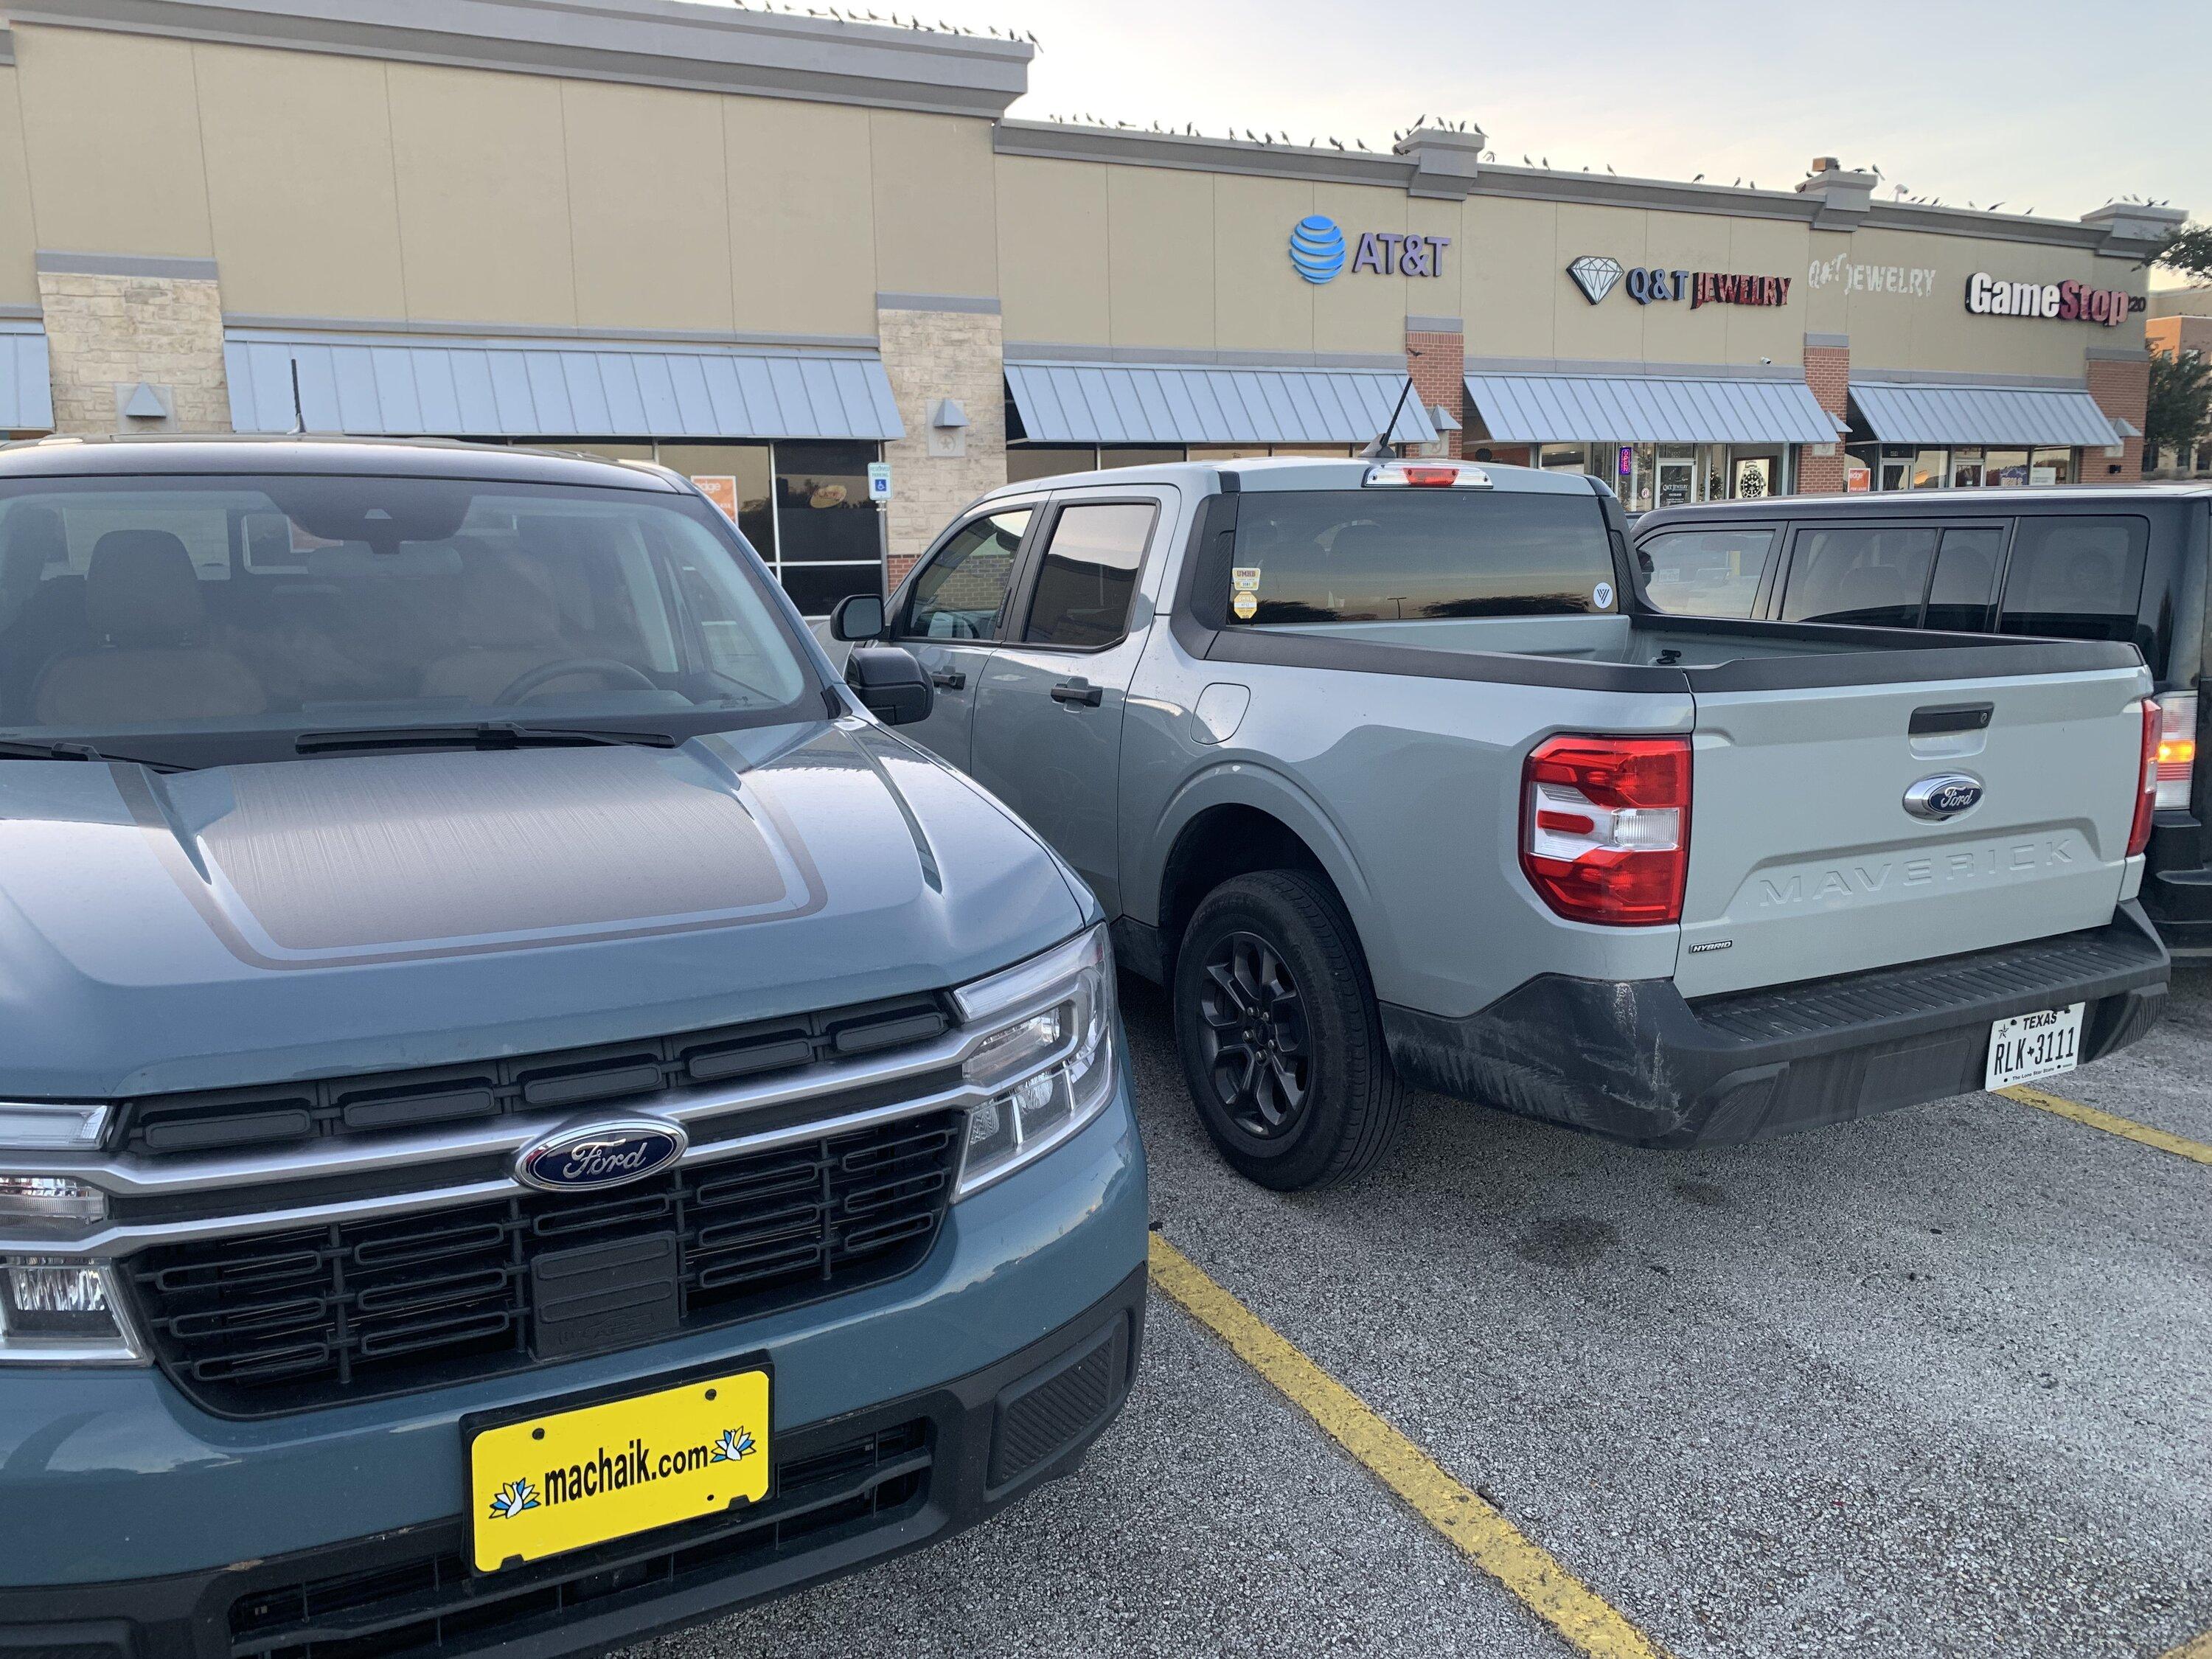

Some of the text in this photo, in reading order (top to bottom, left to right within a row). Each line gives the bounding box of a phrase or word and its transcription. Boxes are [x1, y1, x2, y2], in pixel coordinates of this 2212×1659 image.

[1352, 232, 1451, 277] AT&T
[1626, 267, 1792, 310] Q&T JEWELRY
[1844, 263, 1936, 296] JEWELRY
[1966, 272, 2129, 327] GameStop
[1940, 786, 1974, 808] Ford
[1760, 838, 2072, 907] MAVERICK
[1693, 942, 1731, 952] HYBRID
[2023, 1012, 2057, 1031] TEXAS
[1994, 1026, 2075, 1076] RLK 3111
[563, 1138, 648, 1179] Ford
[545, 1439, 708, 1507] machaik.com
